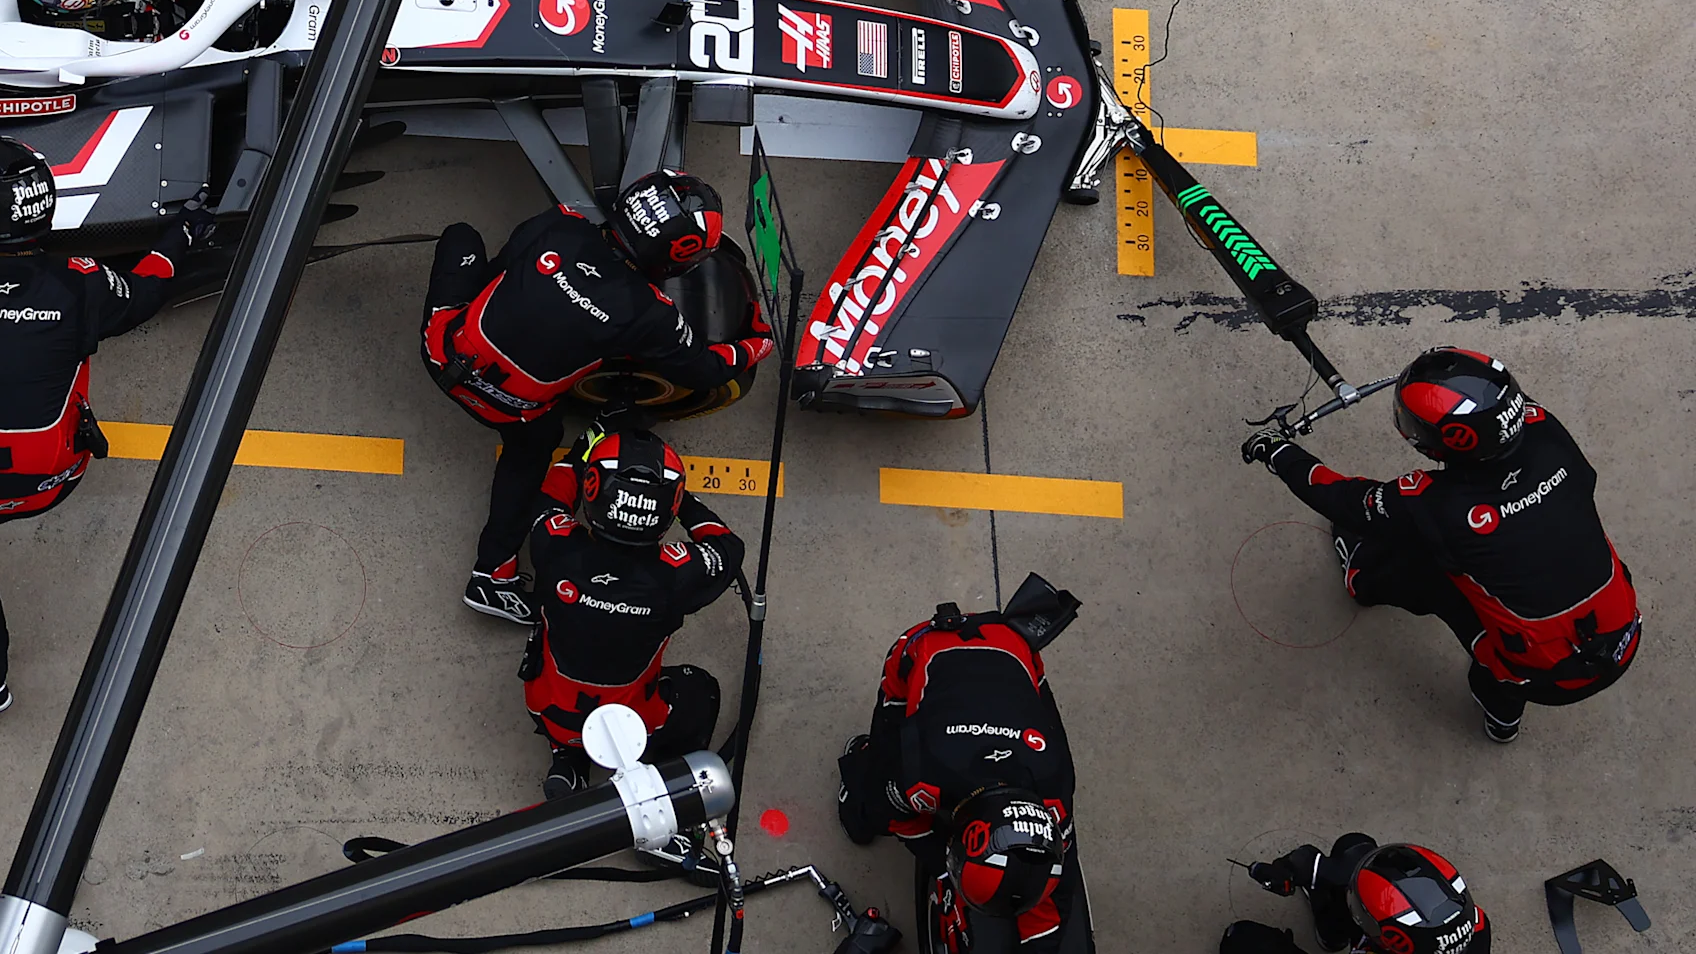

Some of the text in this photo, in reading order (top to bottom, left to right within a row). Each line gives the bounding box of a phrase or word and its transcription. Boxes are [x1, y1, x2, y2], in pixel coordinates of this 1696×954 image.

[813, 12, 833, 69] HAAS
[1132, 34, 1145, 52] 30
[911, 27, 926, 84] PIRELLI
[951, 31, 961, 80] CHIPOTLE
[1136, 169, 1148, 184] 10
[11, 180, 50, 206] Palm
[642, 185, 671, 224] Palm
[10, 193, 54, 222] Angels
[625, 191, 661, 238] Angels
[1136, 200, 1149, 218] 20
[1137, 233, 1150, 252] 30
[809, 158, 961, 374] Money
[552, 271, 610, 323] MoneyGram
[1495, 392, 1525, 429] Palm
[702, 476, 721, 489] 20
[738, 479, 757, 492] 30
[1499, 467, 1568, 519] MoneyGram
[616, 488, 658, 512] Palm
[607, 503, 660, 528] Angels
[579, 593, 652, 616] MoneyGram
[945, 722, 1021, 740] MoneyGram
[1002, 805, 1055, 827] Angels
[1012, 820, 1054, 842] Palm
[1436, 919, 1473, 951] Palm
